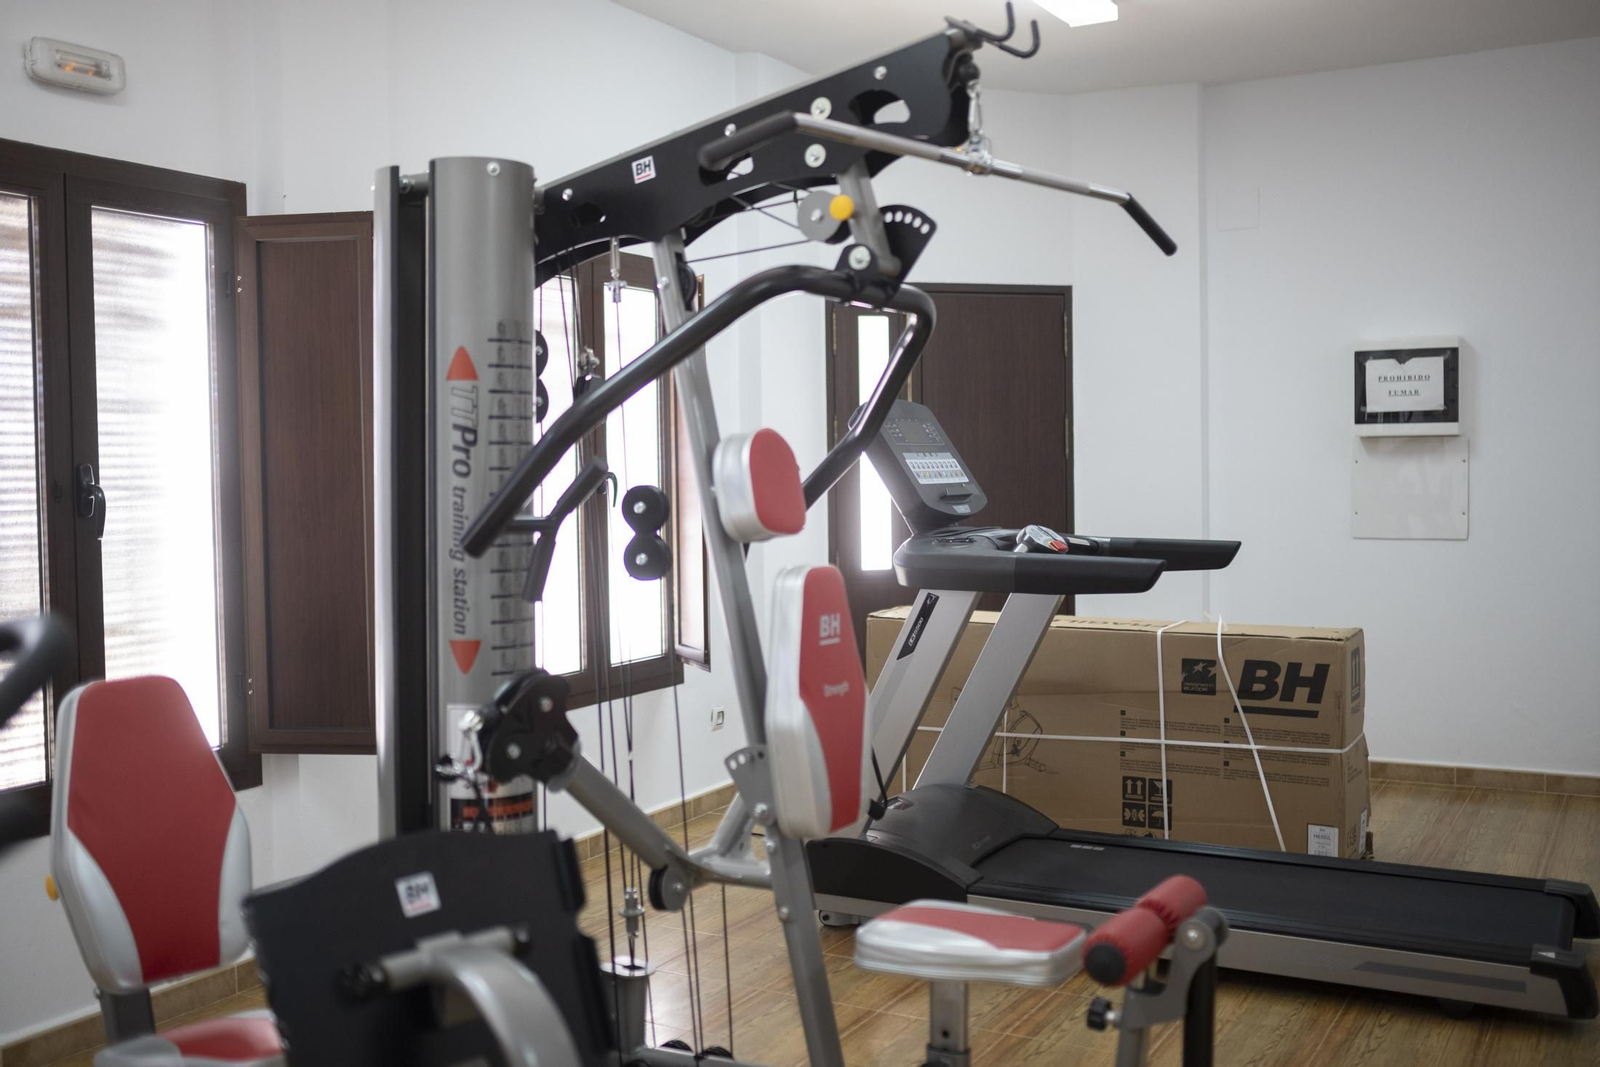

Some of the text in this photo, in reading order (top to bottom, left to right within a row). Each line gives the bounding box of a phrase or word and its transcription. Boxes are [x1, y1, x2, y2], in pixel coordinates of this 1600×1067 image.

[635, 159, 652, 177] BH
[1378, 374, 1431, 383] PROHIBIDO
[1388, 389, 1420, 397] FUMAR
[453, 567, 470, 635] station
[820, 613, 841, 638] BH
[1236, 659, 1331, 704] BH
